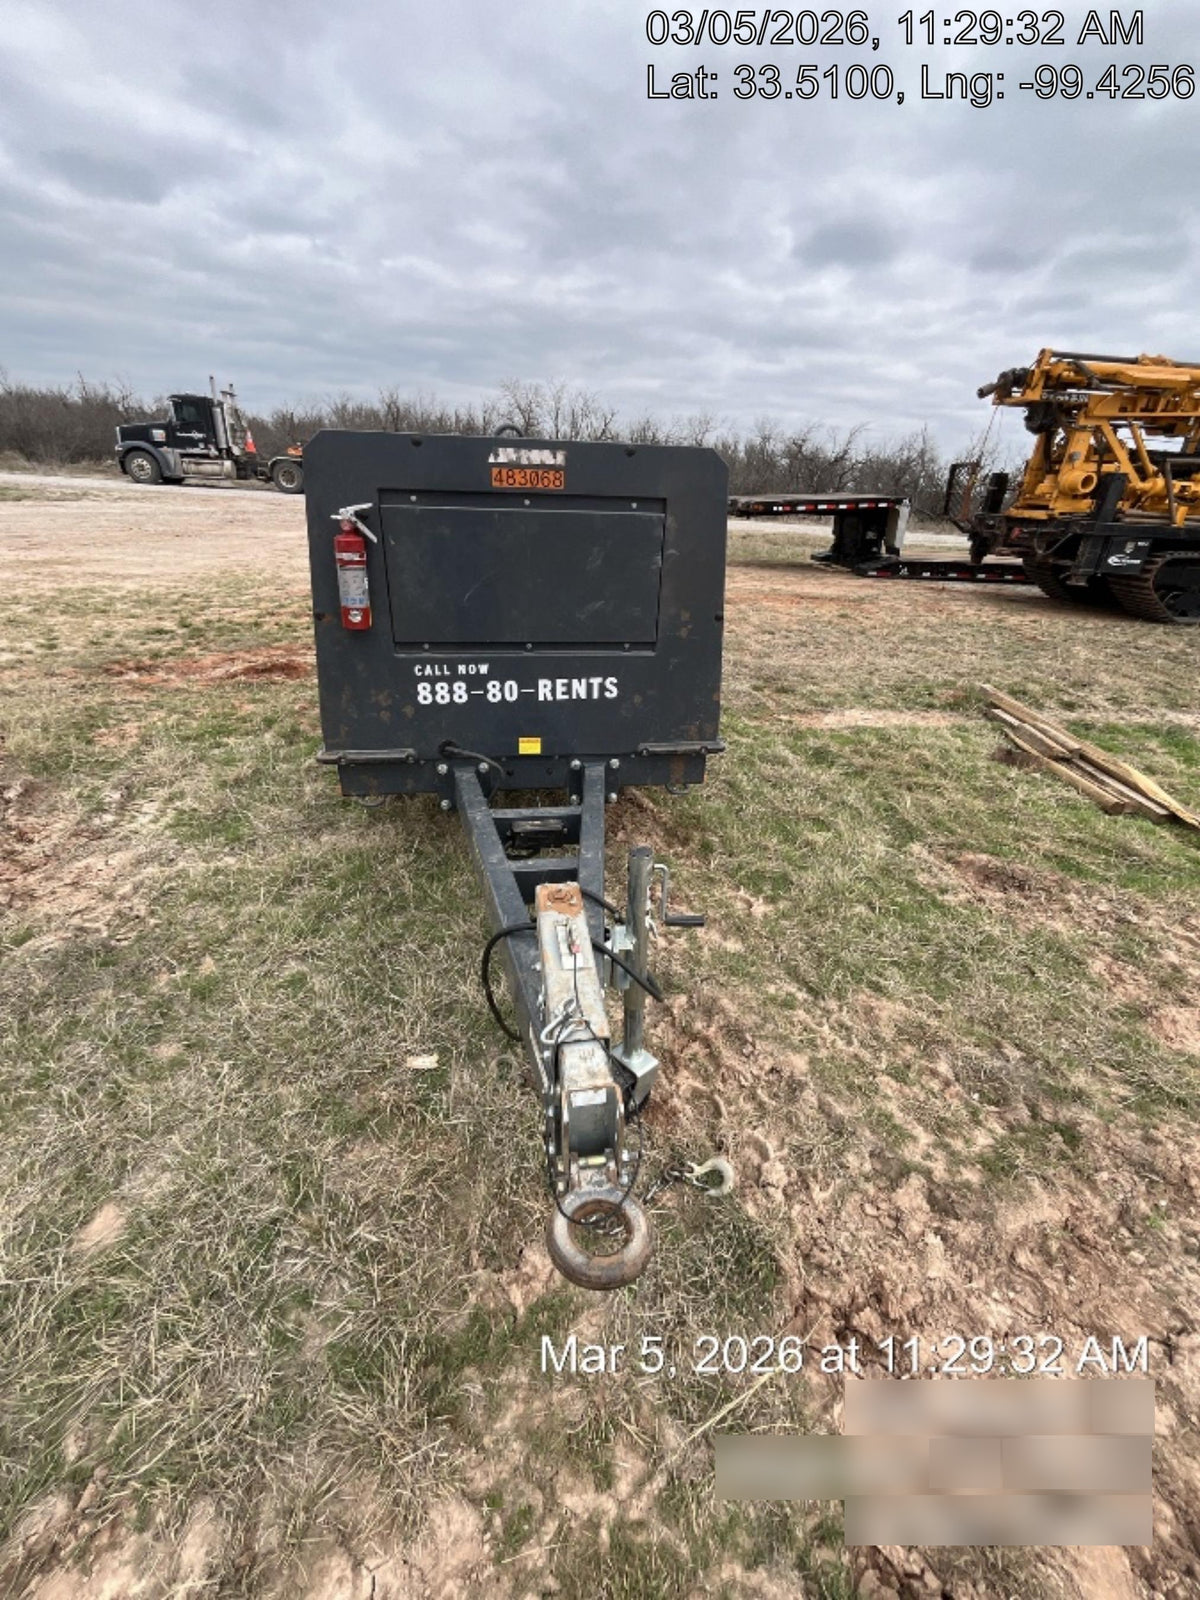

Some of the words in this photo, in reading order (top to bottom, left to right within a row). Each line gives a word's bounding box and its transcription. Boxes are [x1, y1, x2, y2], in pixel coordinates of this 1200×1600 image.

[493, 469, 563, 488] 483068
[414, 664, 451, 676] CALL
[458, 663, 489, 675] NOW
[417, 676, 619, 705] 888-80-RENTS
